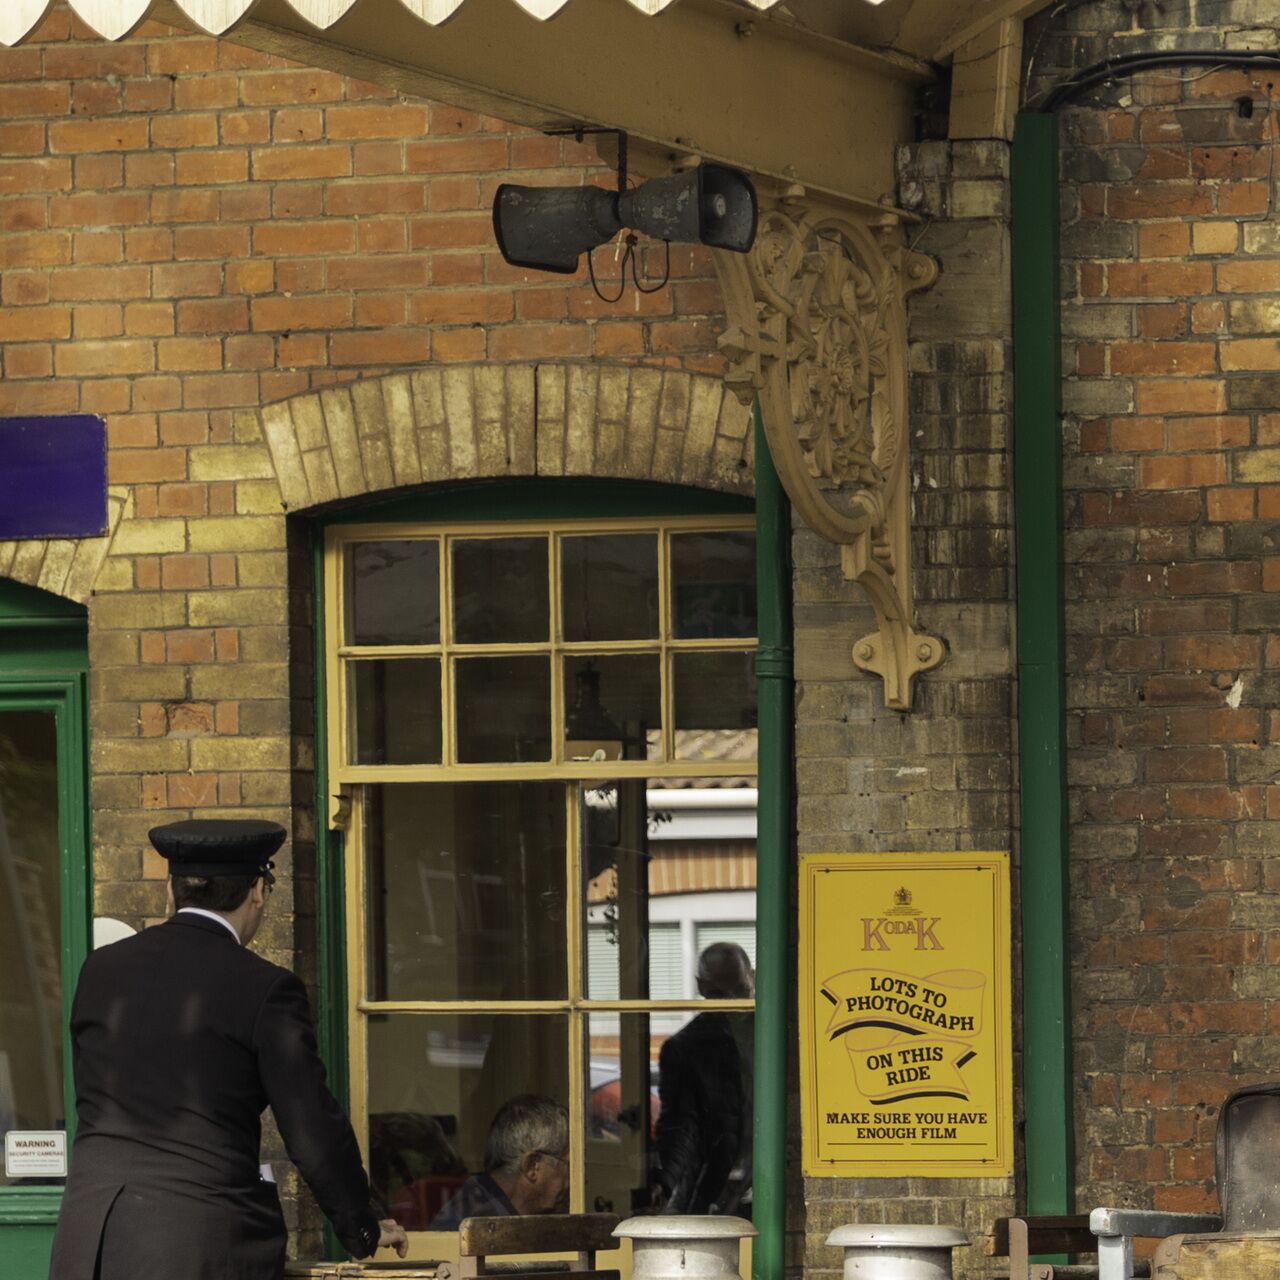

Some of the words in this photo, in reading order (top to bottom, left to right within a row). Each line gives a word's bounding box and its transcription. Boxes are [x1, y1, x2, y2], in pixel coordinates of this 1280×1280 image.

[860, 917, 945, 951] KODAK
[869, 977, 918, 998] LOTS
[922, 987, 947, 1008] TO
[846, 995, 975, 1032] PHOTOGRAPH
[866, 1052, 893, 1070] ON
[898, 1046, 944, 1064] THIS
[886, 1066, 931, 1086] RIDE
[826, 1112, 870, 1125] MAKE
[873, 1112, 911, 1125] SURE
[916, 1112, 944, 1125] YOU
[947, 1112, 987, 1125] HAVE
[15, 1140, 56, 1148] WARNING
[857, 1127, 917, 1139] ENOUGH
[921, 1127, 957, 1139] FILM
